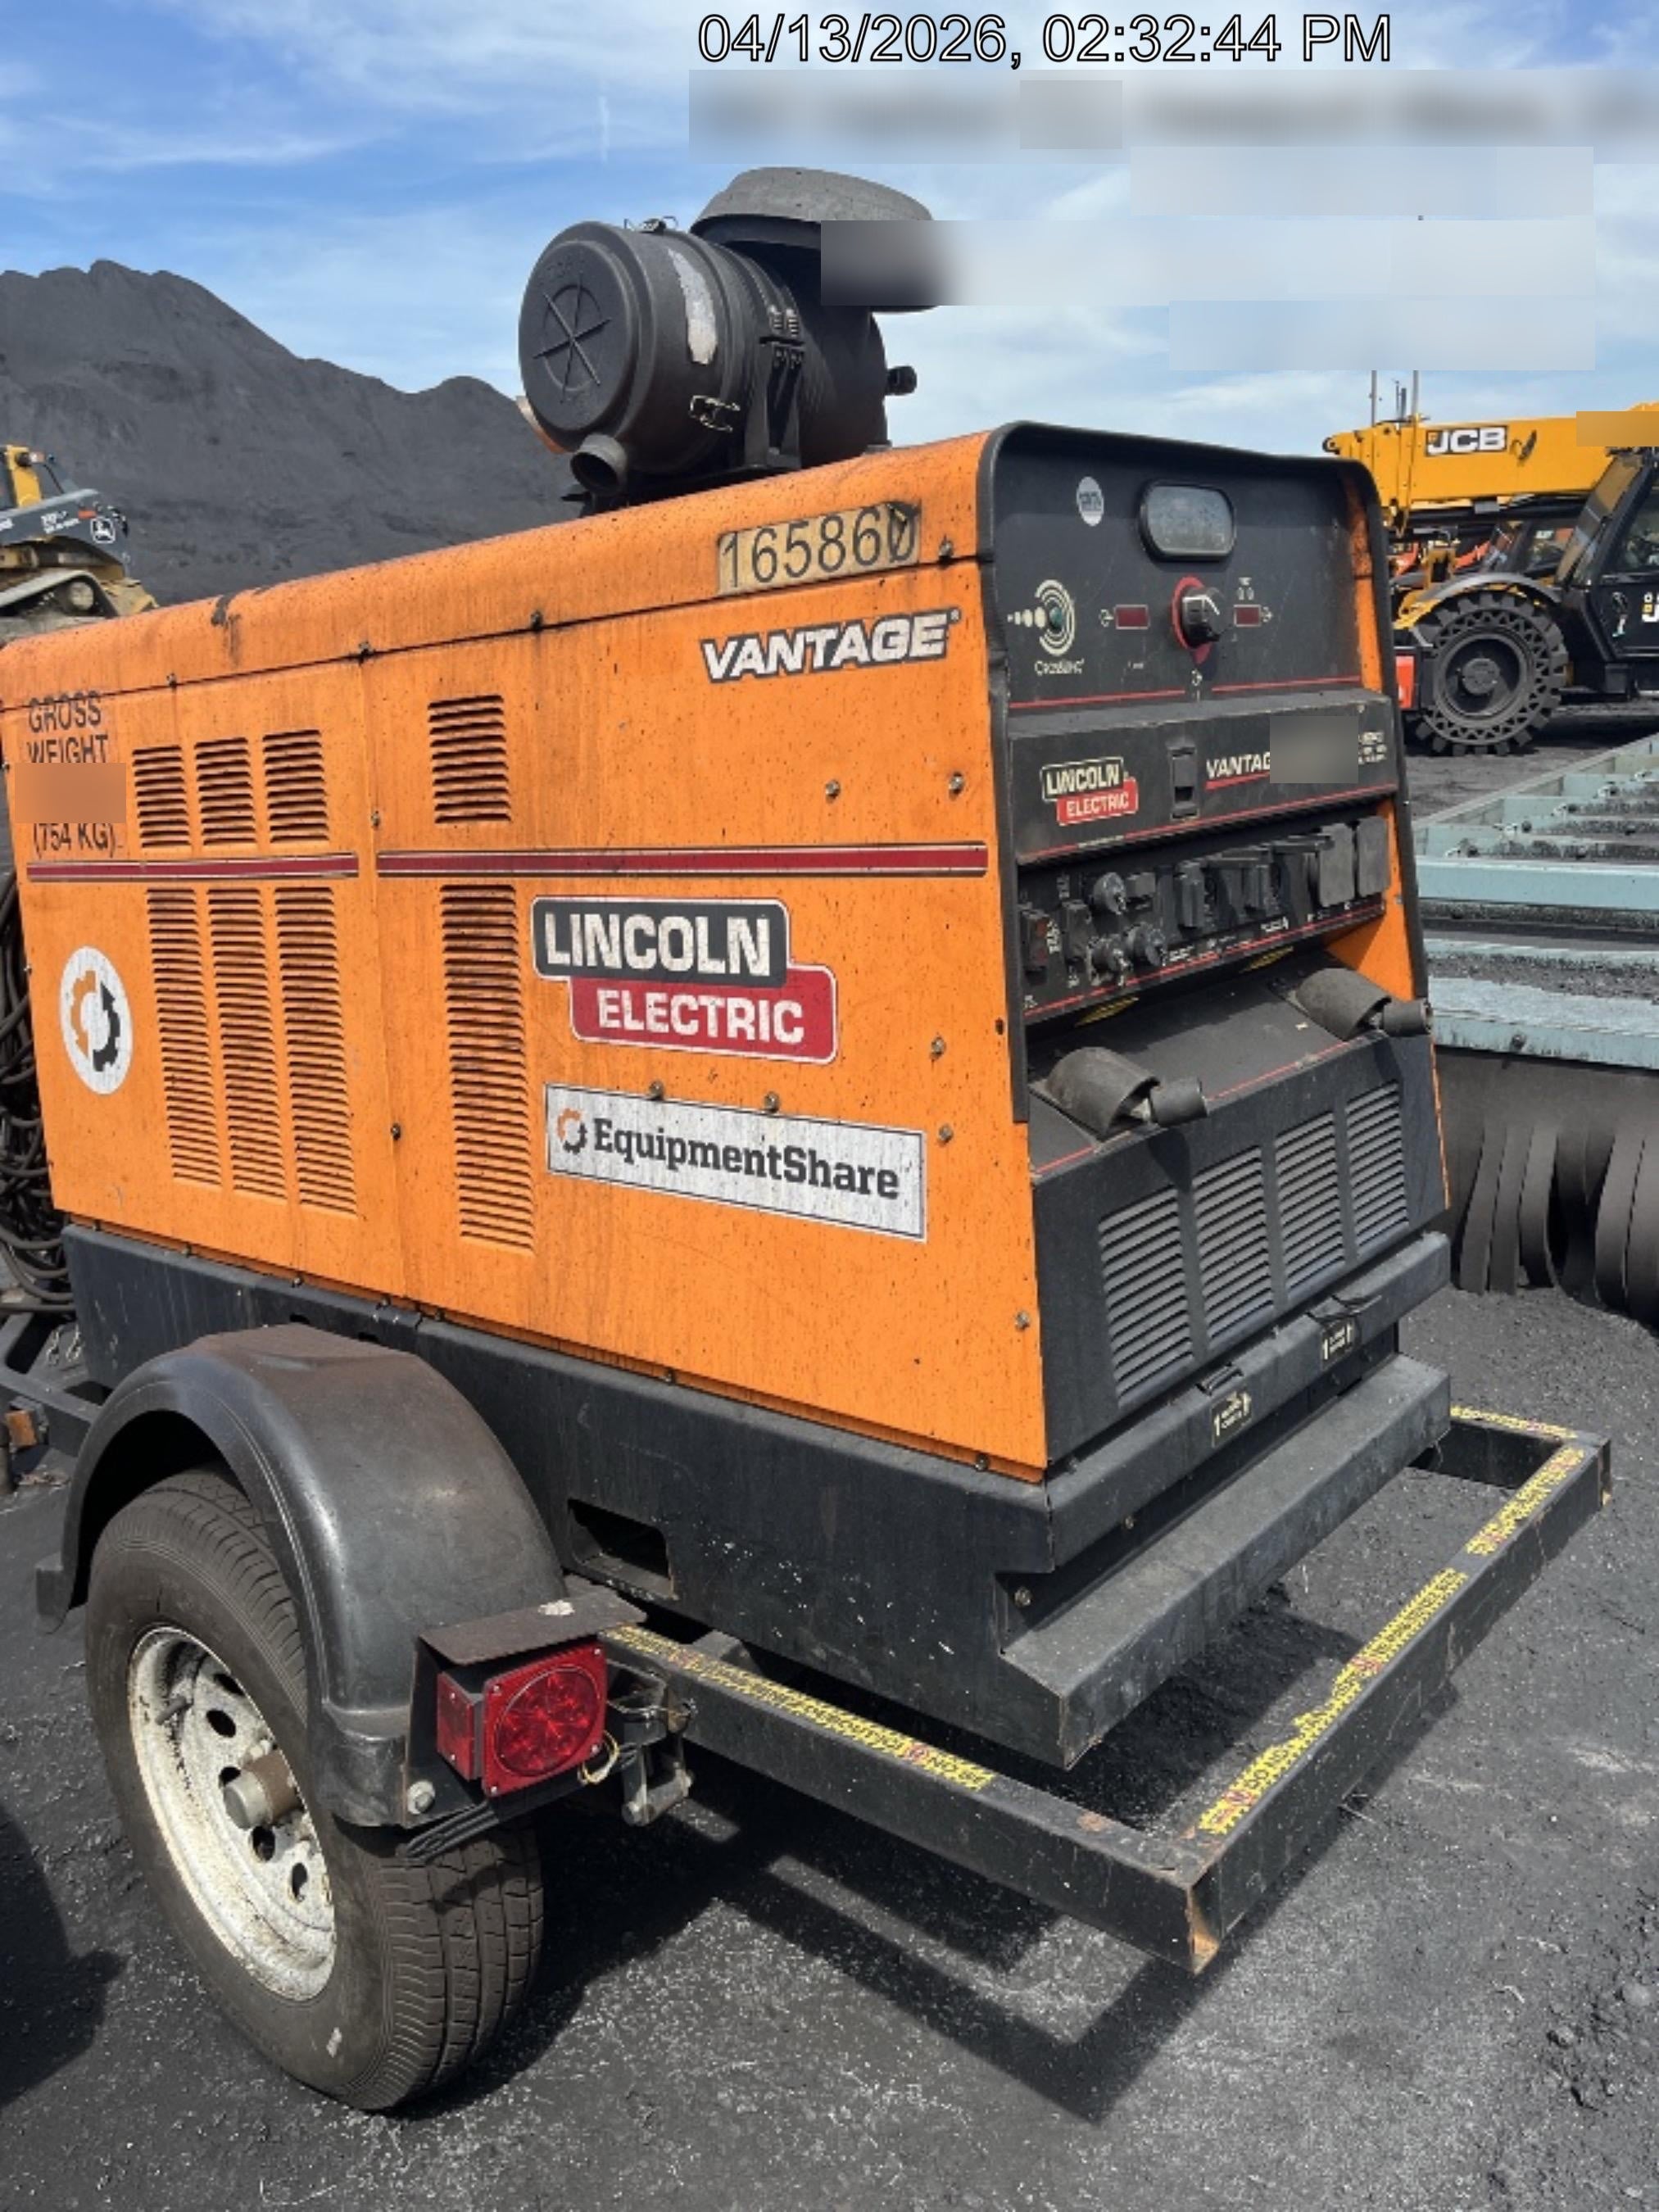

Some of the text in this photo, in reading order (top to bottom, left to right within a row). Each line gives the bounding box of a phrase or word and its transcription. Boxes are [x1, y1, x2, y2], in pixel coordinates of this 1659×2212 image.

[1427, 426, 1506, 456] JCB
[722, 502, 916, 588] 165860
[700, 607, 953, 683] VANTAGE
[29, 690, 101, 733] GROSS
[1046, 763, 1120, 796] LINCOLN
[1206, 751, 1271, 780] VANTAG
[1066, 791, 1130, 818] ELECTRIC
[544, 911, 771, 977] LINCOLN
[596, 987, 805, 1045] ELECTRIC
[592, 1117, 900, 1201] EquipmentShare
